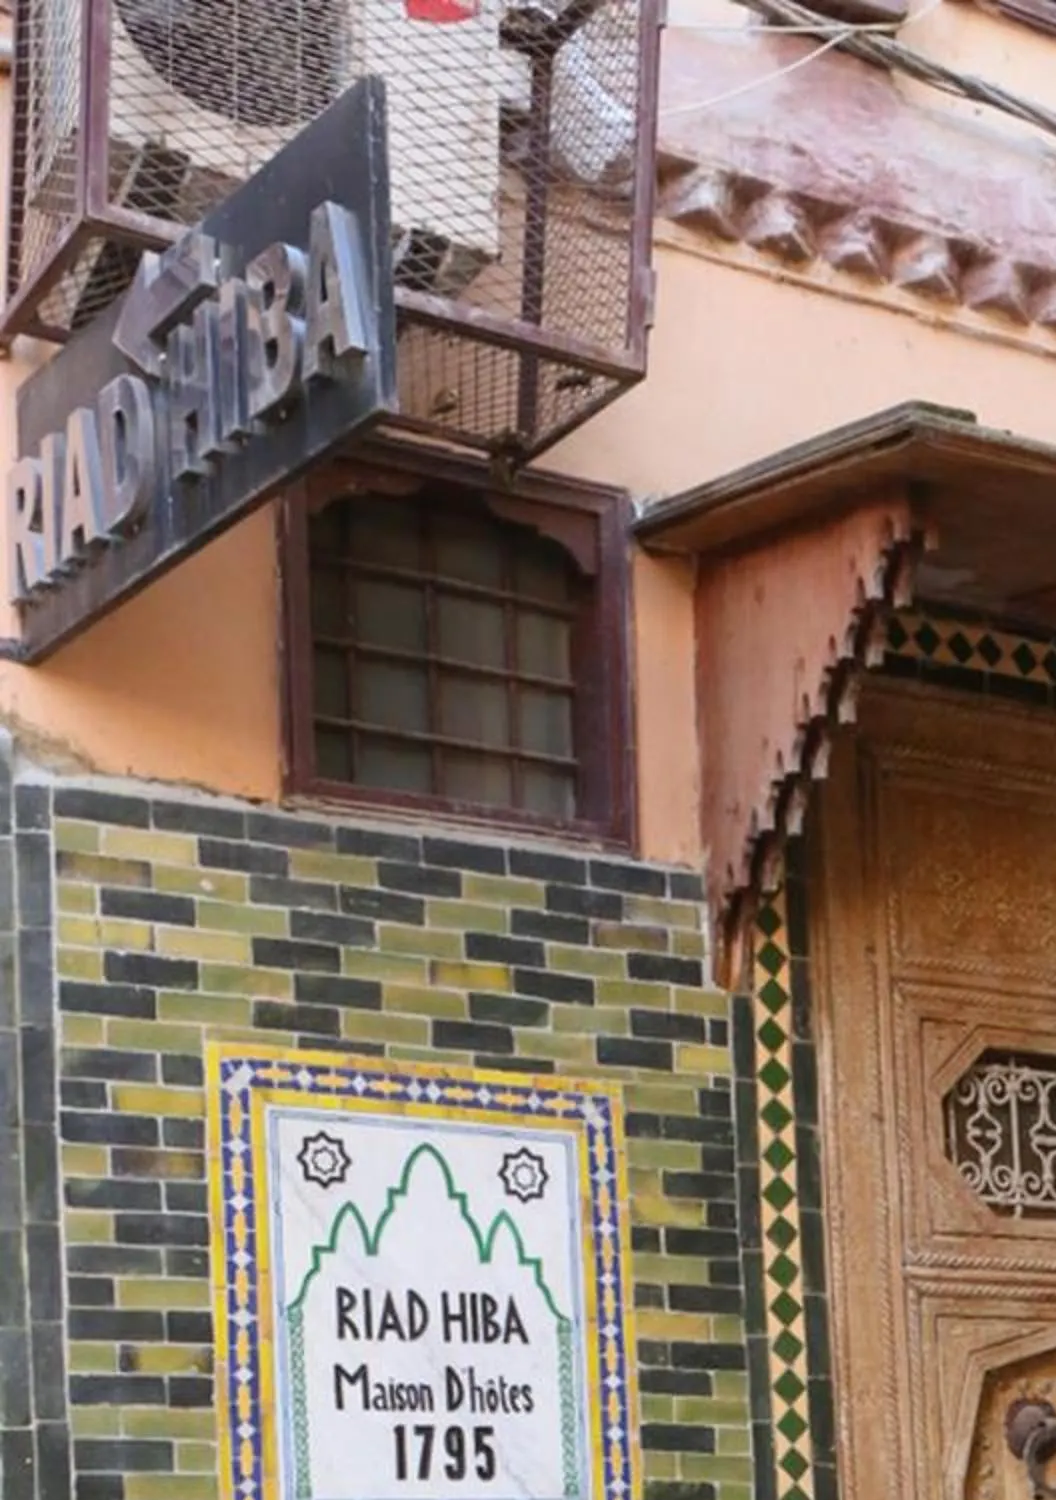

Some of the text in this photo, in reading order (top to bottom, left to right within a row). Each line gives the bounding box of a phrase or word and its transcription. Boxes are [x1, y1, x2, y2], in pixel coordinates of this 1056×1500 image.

[6, 200, 370, 598] RIAD HIBA
[335, 1286, 530, 1345] RIAD HIBA
[333, 1362, 435, 1413] Maison
[393, 1423, 497, 1482] 1795
